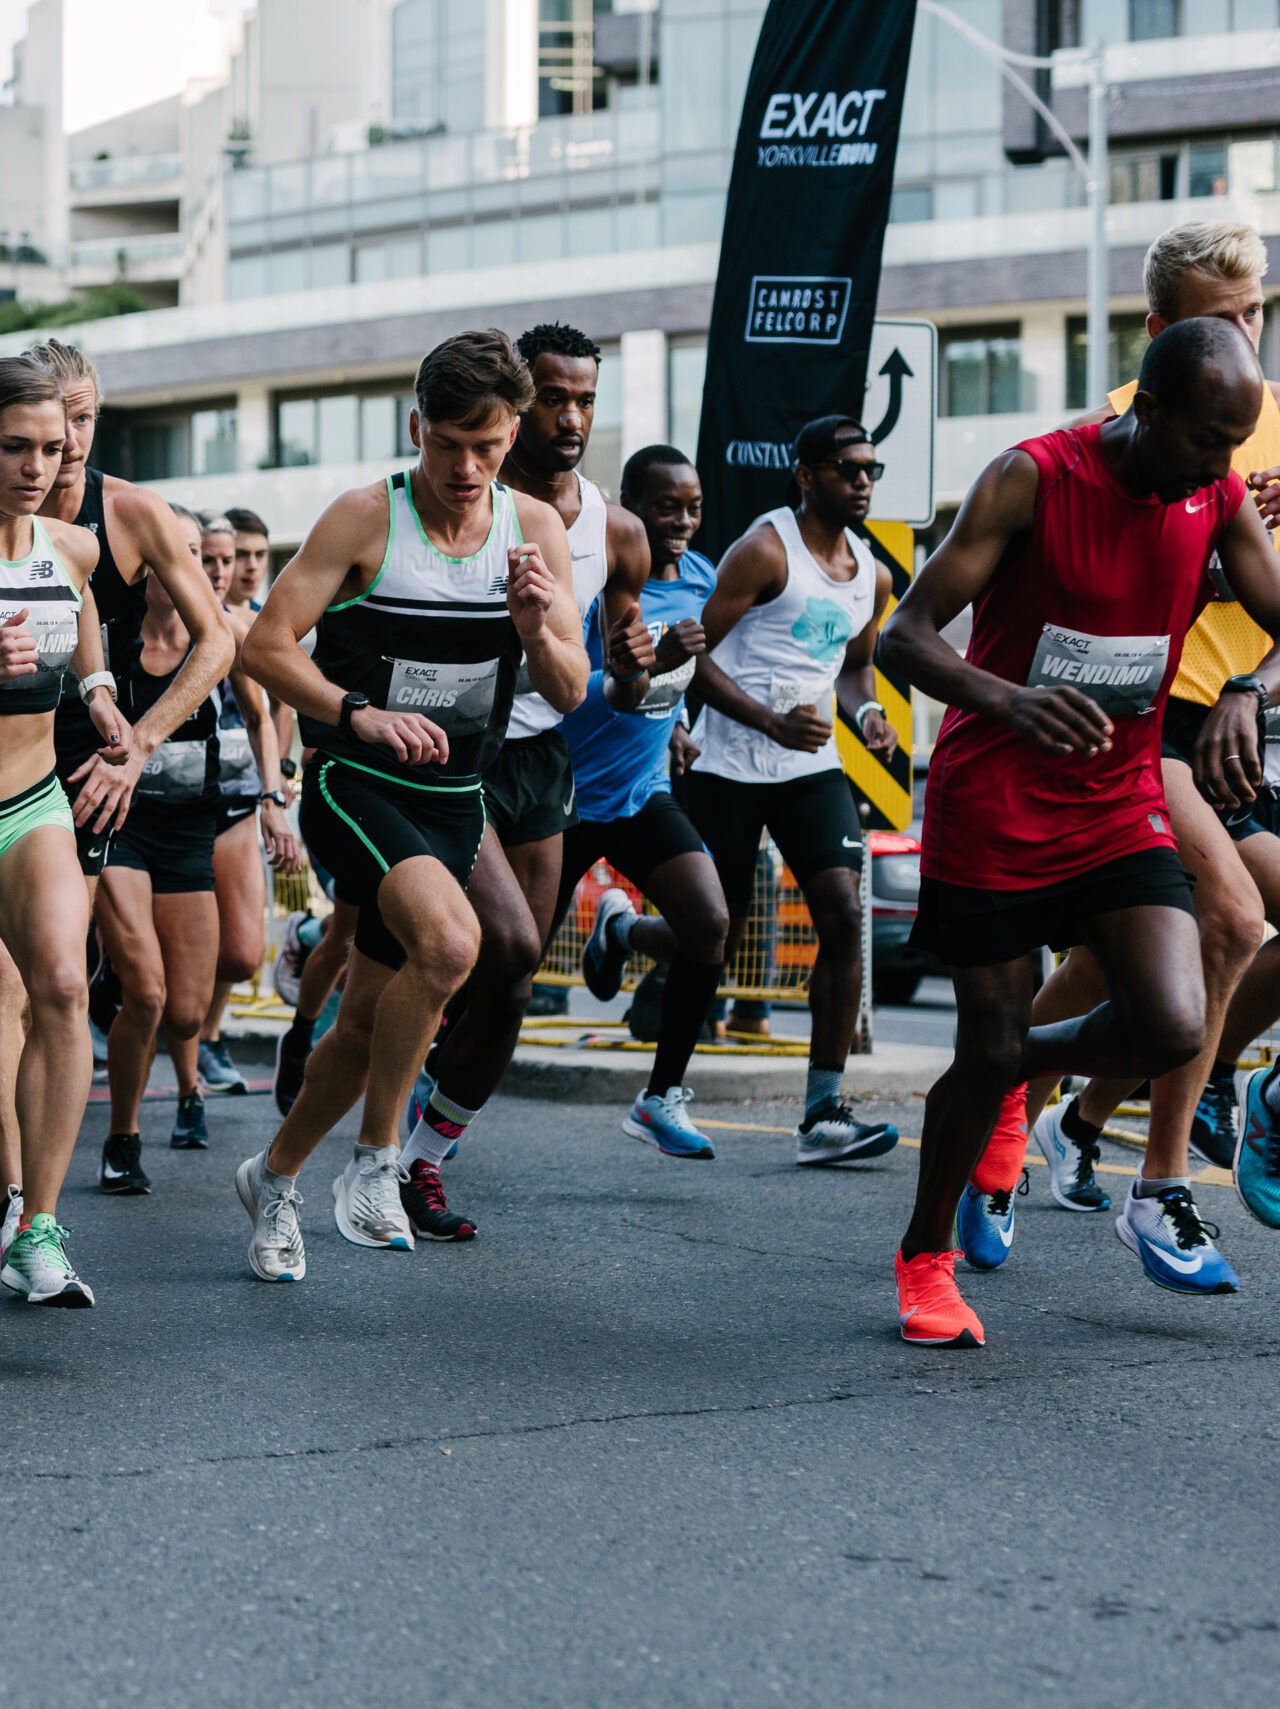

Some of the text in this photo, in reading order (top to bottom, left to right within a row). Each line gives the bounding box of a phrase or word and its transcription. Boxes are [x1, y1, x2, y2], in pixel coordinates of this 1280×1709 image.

[759, 89, 887, 139] EXACT
[757, 288, 840, 309] CAMROST
[753, 311, 838, 333] FELCORP
[1053, 632, 1091, 649] EXACT
[405, 666, 438, 678] EXACT
[1041, 654, 1154, 686] WENDIMU
[396, 686, 459, 708] CHRIS
